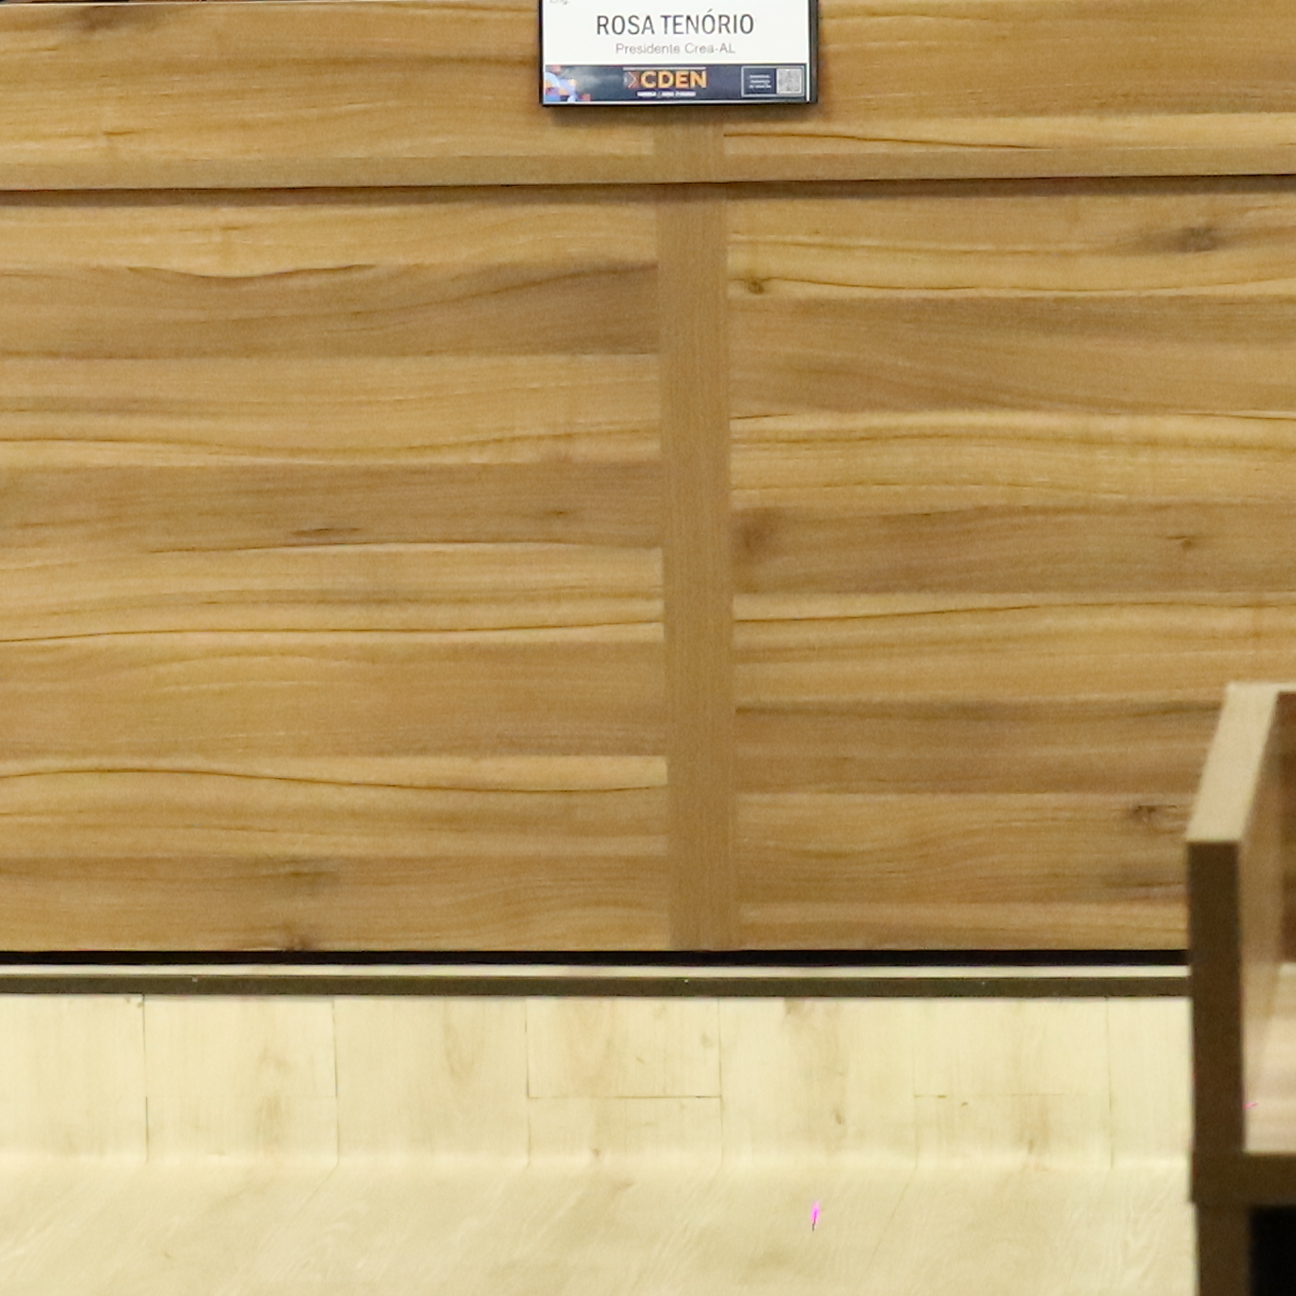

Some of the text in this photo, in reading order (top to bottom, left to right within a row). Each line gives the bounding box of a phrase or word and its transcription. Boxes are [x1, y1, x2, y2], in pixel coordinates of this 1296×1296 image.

[595, 9, 755, 36] ROSA TENÓRIO
[615, 42, 736, 55] Presidente Crea-AL
[640, 69, 708, 89] CDEN
